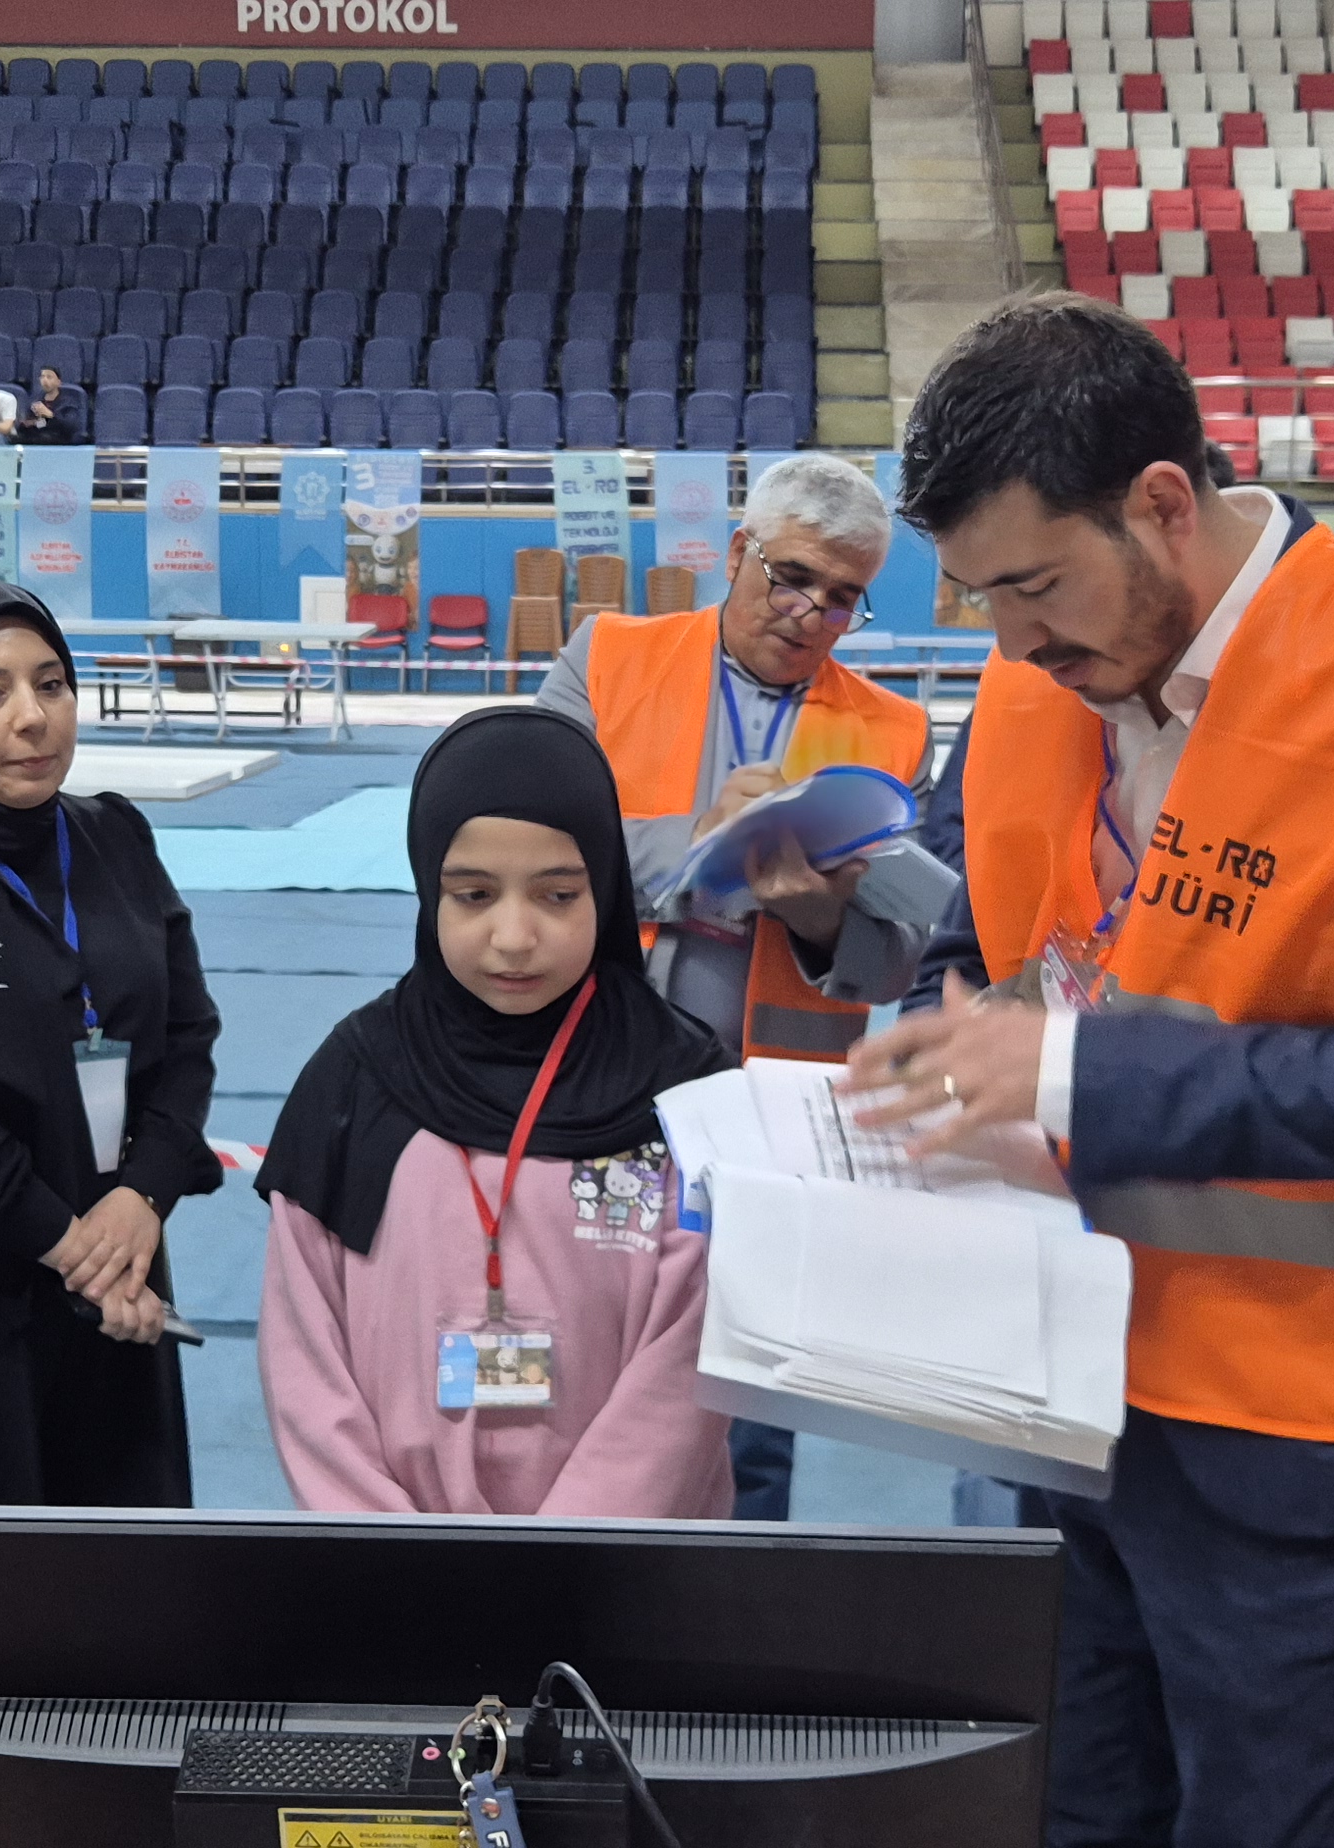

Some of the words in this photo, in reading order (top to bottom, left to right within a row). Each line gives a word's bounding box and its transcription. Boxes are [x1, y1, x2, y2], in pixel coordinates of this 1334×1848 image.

[236, 0, 459, 34] PROTOKOL
[582, 460, 597, 475] 3.
[562, 480, 581, 495] EL
[1149, 811, 1189, 859] EL
[1139, 871, 1257, 937] JÜRİ
[487, 1830, 510, 1848] F
